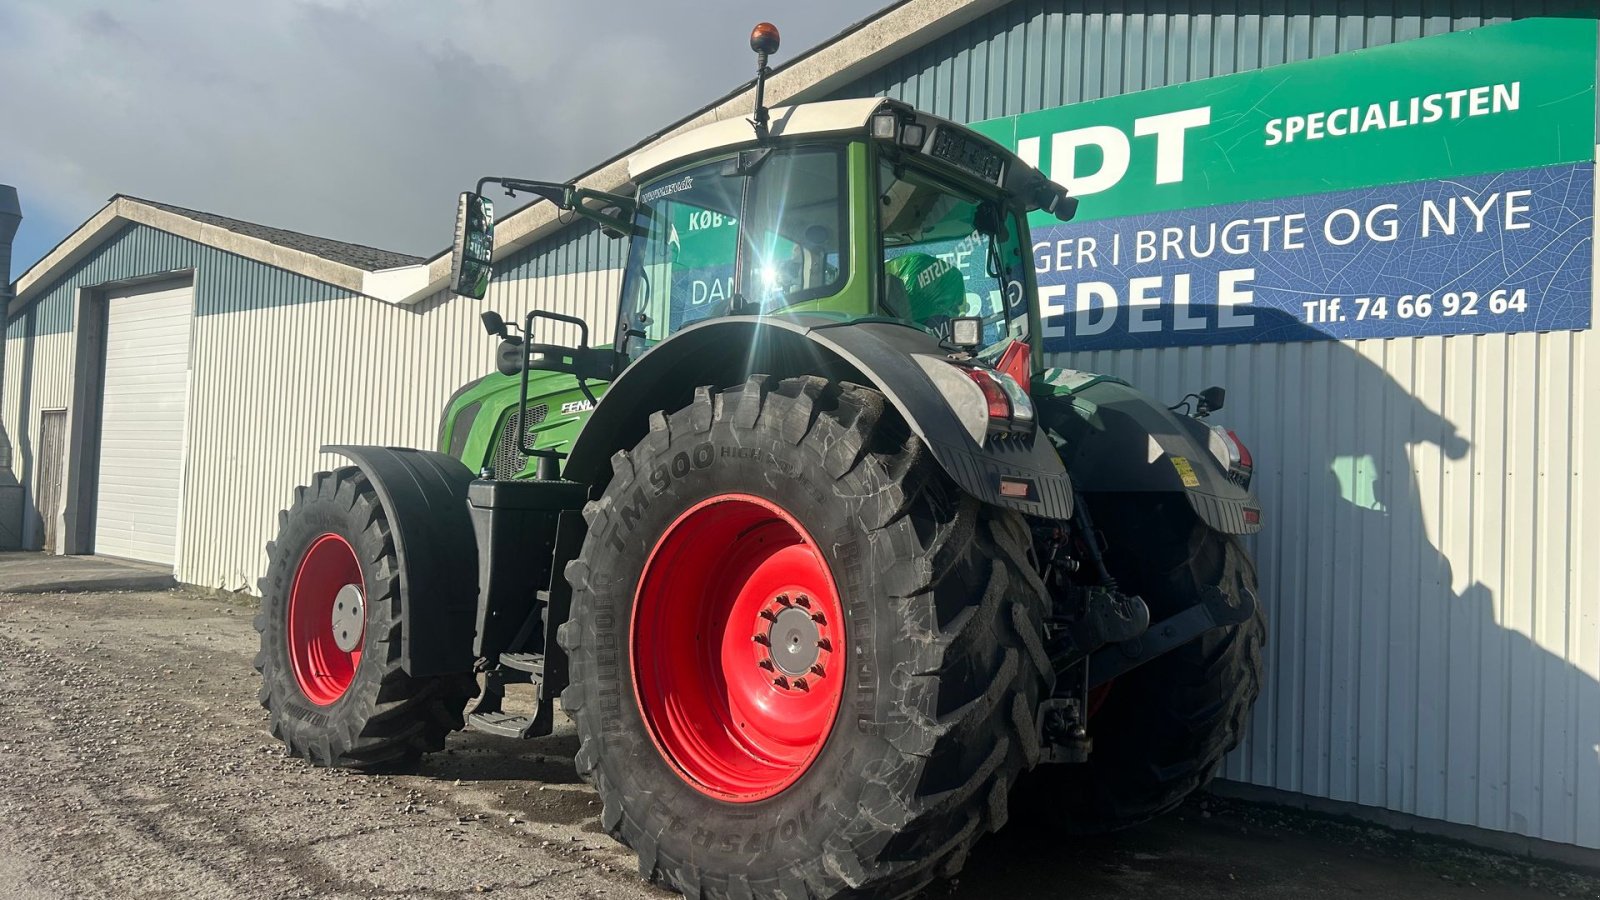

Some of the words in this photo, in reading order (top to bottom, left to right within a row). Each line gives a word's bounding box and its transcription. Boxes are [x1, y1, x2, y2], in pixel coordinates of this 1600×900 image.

[1265, 82, 1520, 146] SPECIALISTEN
[1113, 233, 1120, 266] I
[1136, 213, 1306, 264] BRUGTE
[1324, 203, 1398, 246] OG
[1421, 189, 1532, 238] NYE
[1302, 298, 1346, 323] Tlf.
[1355, 296, 1388, 321] 74
[1397, 294, 1432, 319] 66
[1442, 291, 1478, 317] 92
[1489, 288, 1528, 315] 64
[605, 486, 650, 553] TM
[648, 441, 715, 496] 900
